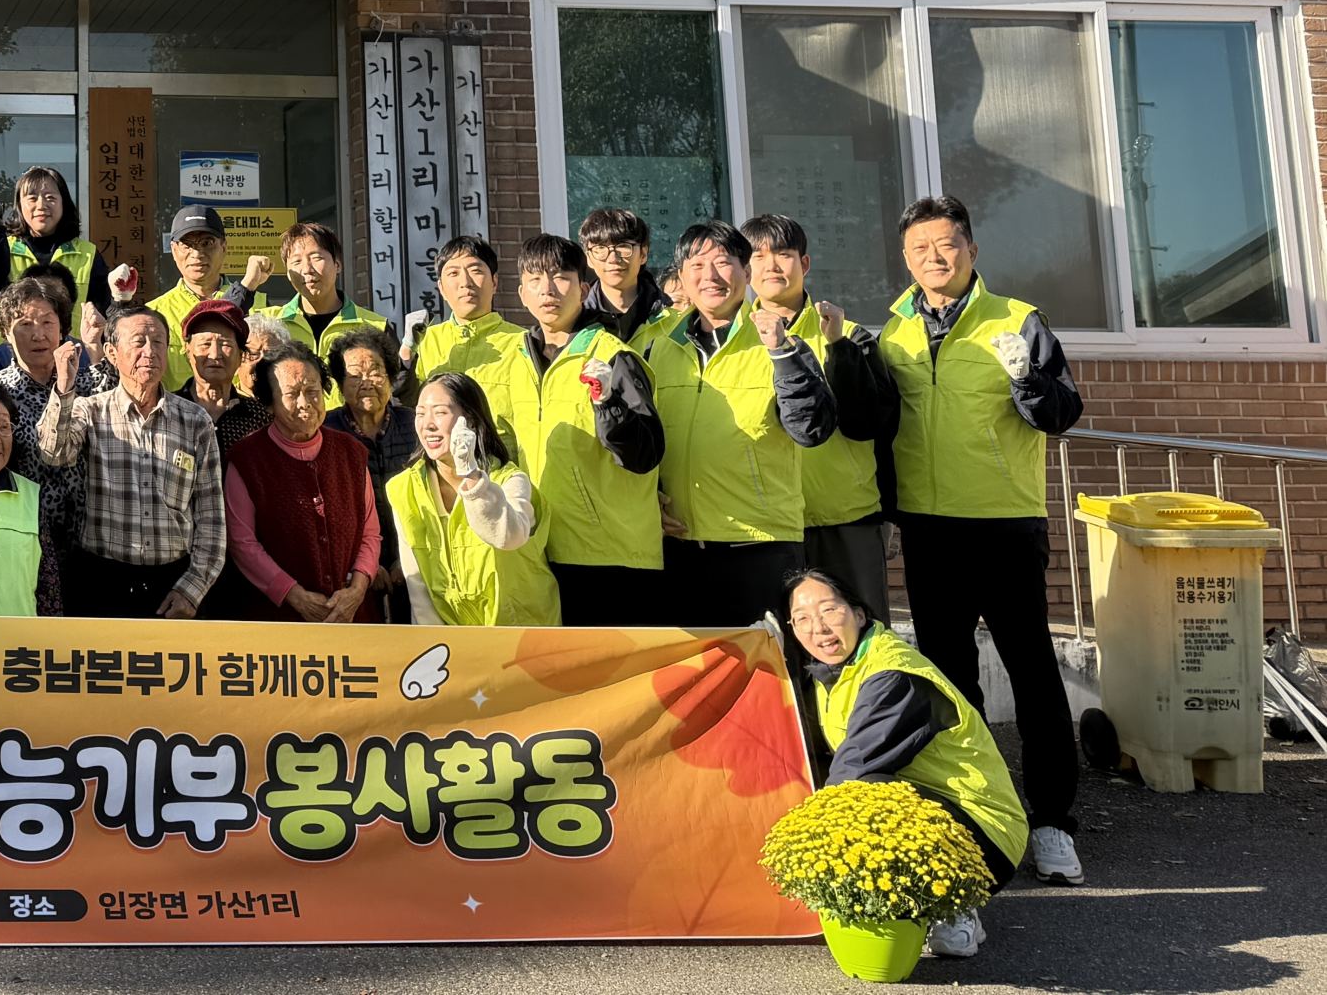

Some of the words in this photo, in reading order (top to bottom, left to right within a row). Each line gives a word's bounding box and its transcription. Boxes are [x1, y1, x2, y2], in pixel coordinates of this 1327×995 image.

[456, 70, 483, 239] 가산1리
[99, 141, 122, 219] 입장면
[128, 142, 147, 245] 대한노인회
[191, 174, 212, 187] 치안
[214, 174, 246, 188] 사랑방
[367, 56, 398, 336] 가산1리할머니
[222, 215, 275, 229] 을대피소
[223, 230, 260, 238] vacuation
[1175, 576, 1236, 590] 음식물쓰레기
[1176, 591, 1236, 604] 전용수거용기
[2, 647, 208, 696] 충남본부가
[217, 652, 379, 699] 함께하는
[261, 732, 612, 854] 봉사활동
[8, 894, 58, 919] 장소
[98, 891, 189, 920] 입장면
[196, 890, 301, 919] 가산1리
